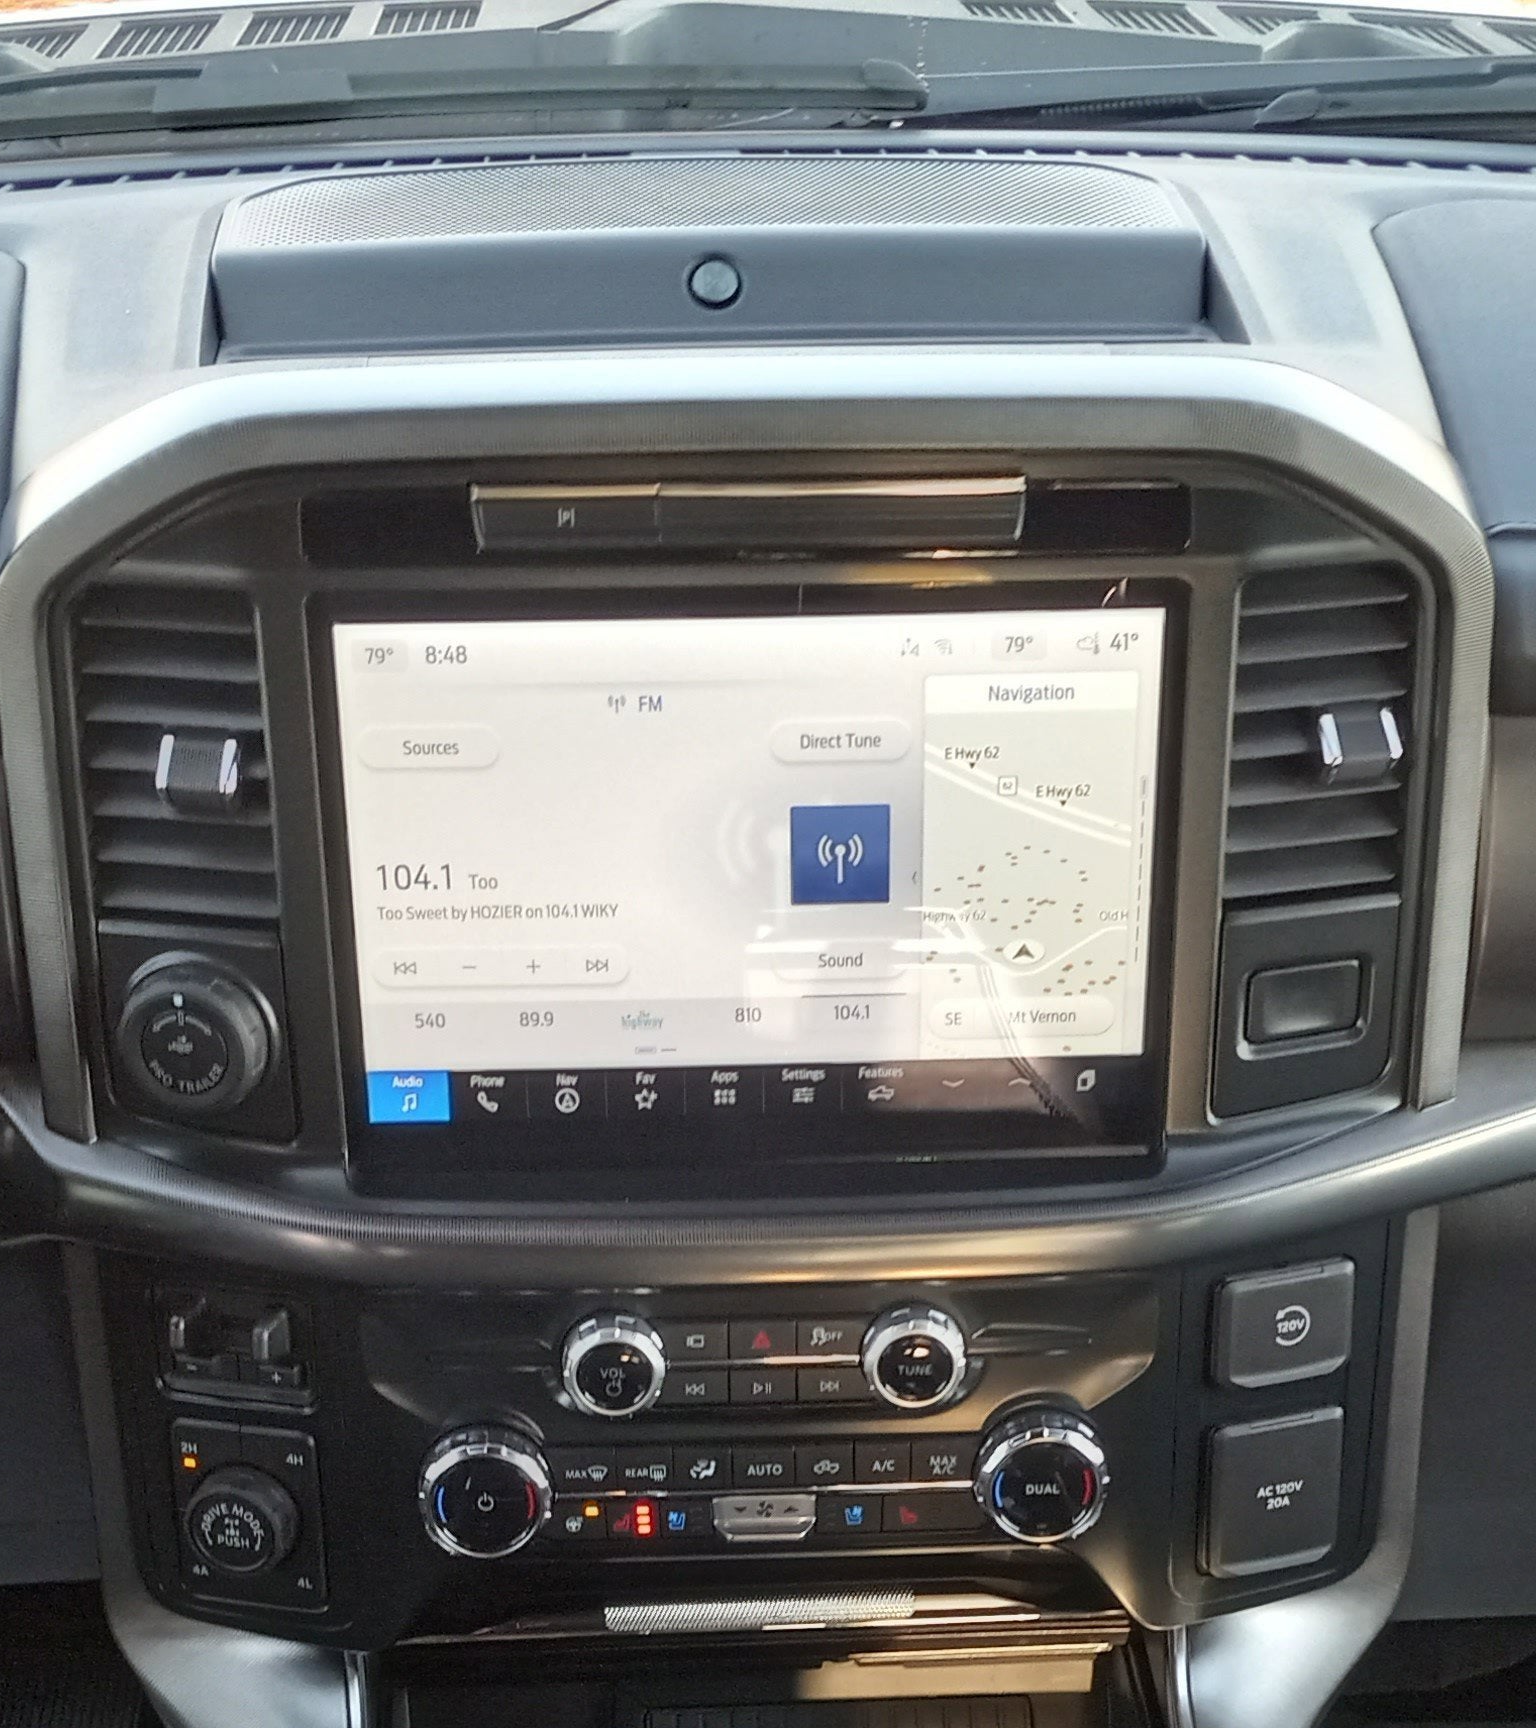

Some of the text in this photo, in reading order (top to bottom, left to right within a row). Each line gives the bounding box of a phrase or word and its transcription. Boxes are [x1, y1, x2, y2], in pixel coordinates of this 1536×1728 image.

[1005, 636, 1033, 653] 79°
[1109, 633, 1139, 651] 41°
[365, 645, 468, 665] 79° 8:48
[988, 685, 1075, 704] Navigation
[638, 695, 663, 713] FM
[402, 741, 460, 756] Sources
[800, 733, 881, 750] Direct Tune
[955, 747, 983, 761] Hwy
[984, 746, 1000, 759] 62
[1046, 785, 1073, 799] Hwy
[1075, 784, 1091, 797] 62
[376, 864, 498, 891] 104.1 Too
[377, 903, 618, 921] Too Sweet by HOZIER on 104.1 WIKY
[818, 953, 863, 968] Sound
[519, 1011, 554, 1027] 89.9
[735, 1007, 761, 1023] 810
[834, 1005, 870, 1020] 104.1
[944, 1012, 962, 1026] SE
[1029, 1010, 1076, 1024] Vernon
[415, 1013, 446, 1029] 540
[556, 1074, 578, 1087] Nav
[635, 1072, 656, 1085] Fav
[710, 1070, 739, 1085] Apps
[782, 1068, 826, 1083] Settings
[858, 1067, 903, 1080] Features
[392, 1075, 423, 1088] Audio
[470, 1075, 504, 1088] Phone
[1276, 1317, 1306, 1334] 120V
[600, 1367, 626, 1380] VOL
[897, 1364, 933, 1377] TUNE
[286, 1453, 304, 1466] 4H
[872, 1458, 895, 1472] A/C
[929, 1454, 957, 1467] MAX
[565, 1469, 587, 1480] MAX
[625, 1467, 648, 1478] REAR
[747, 1464, 783, 1477] AUTO
[1025, 1482, 1060, 1496] DUAL
[1257, 1480, 1303, 1499] AC 120V
[1266, 1496, 1290, 1510] 20A
[201, 1503, 265, 1537] DRIVE MODE
[217, 1534, 249, 1548] PUSH
